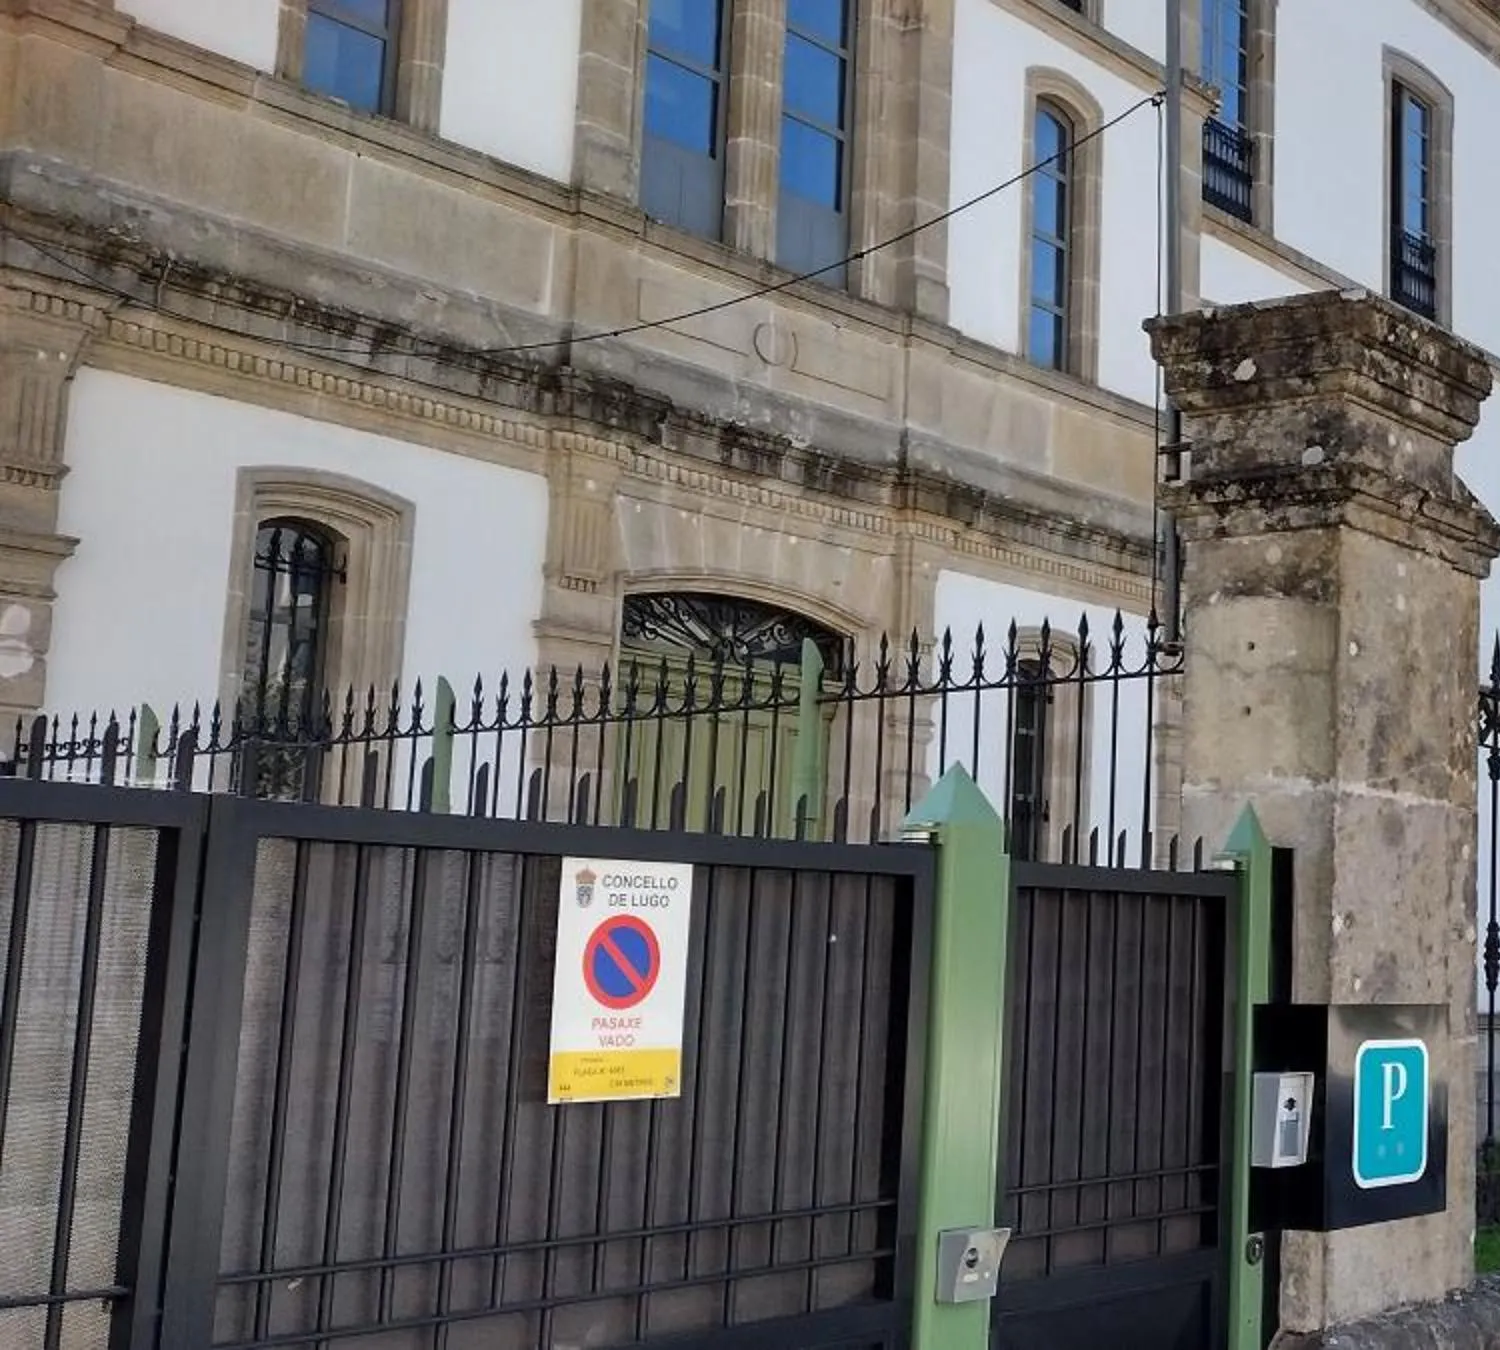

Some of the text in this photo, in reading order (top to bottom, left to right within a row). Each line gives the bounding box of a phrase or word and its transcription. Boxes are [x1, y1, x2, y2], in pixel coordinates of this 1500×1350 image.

[602, 874, 679, 890] CONCELLO
[608, 893, 670, 908] DE LUGO
[591, 1017, 642, 1030] PASAXE
[598, 1034, 635, 1047] VADO
[1381, 1062, 1407, 1130] P
